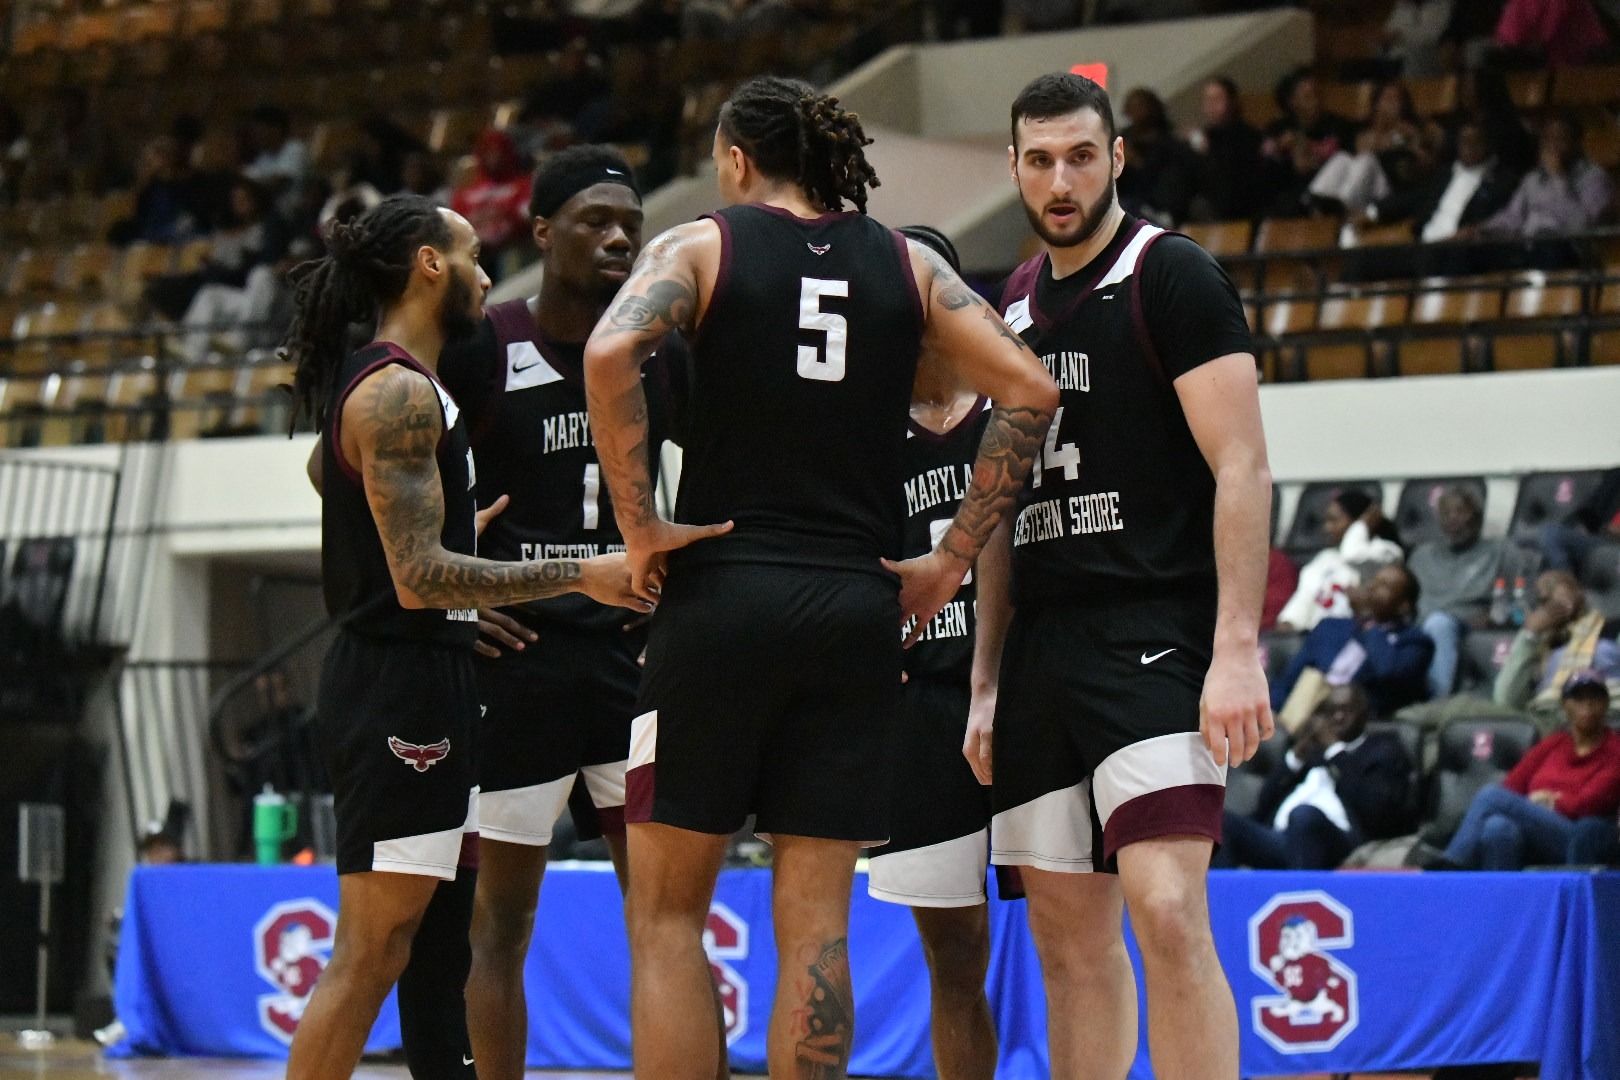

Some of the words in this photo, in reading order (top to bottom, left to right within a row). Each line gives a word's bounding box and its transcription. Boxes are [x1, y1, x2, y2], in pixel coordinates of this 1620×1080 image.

[797, 277, 849, 382] 5
[1039, 351, 1091, 393] YLAND
[542, 411, 595, 455] MARY
[582, 463, 600, 530] 1
[903, 463, 976, 518] MARYLA
[1013, 498, 1064, 548] EASTERN
[1068, 491, 1124, 536] SHORE
[521, 561, 581, 582] GOD
[1248, 890, 1360, 1055] S
